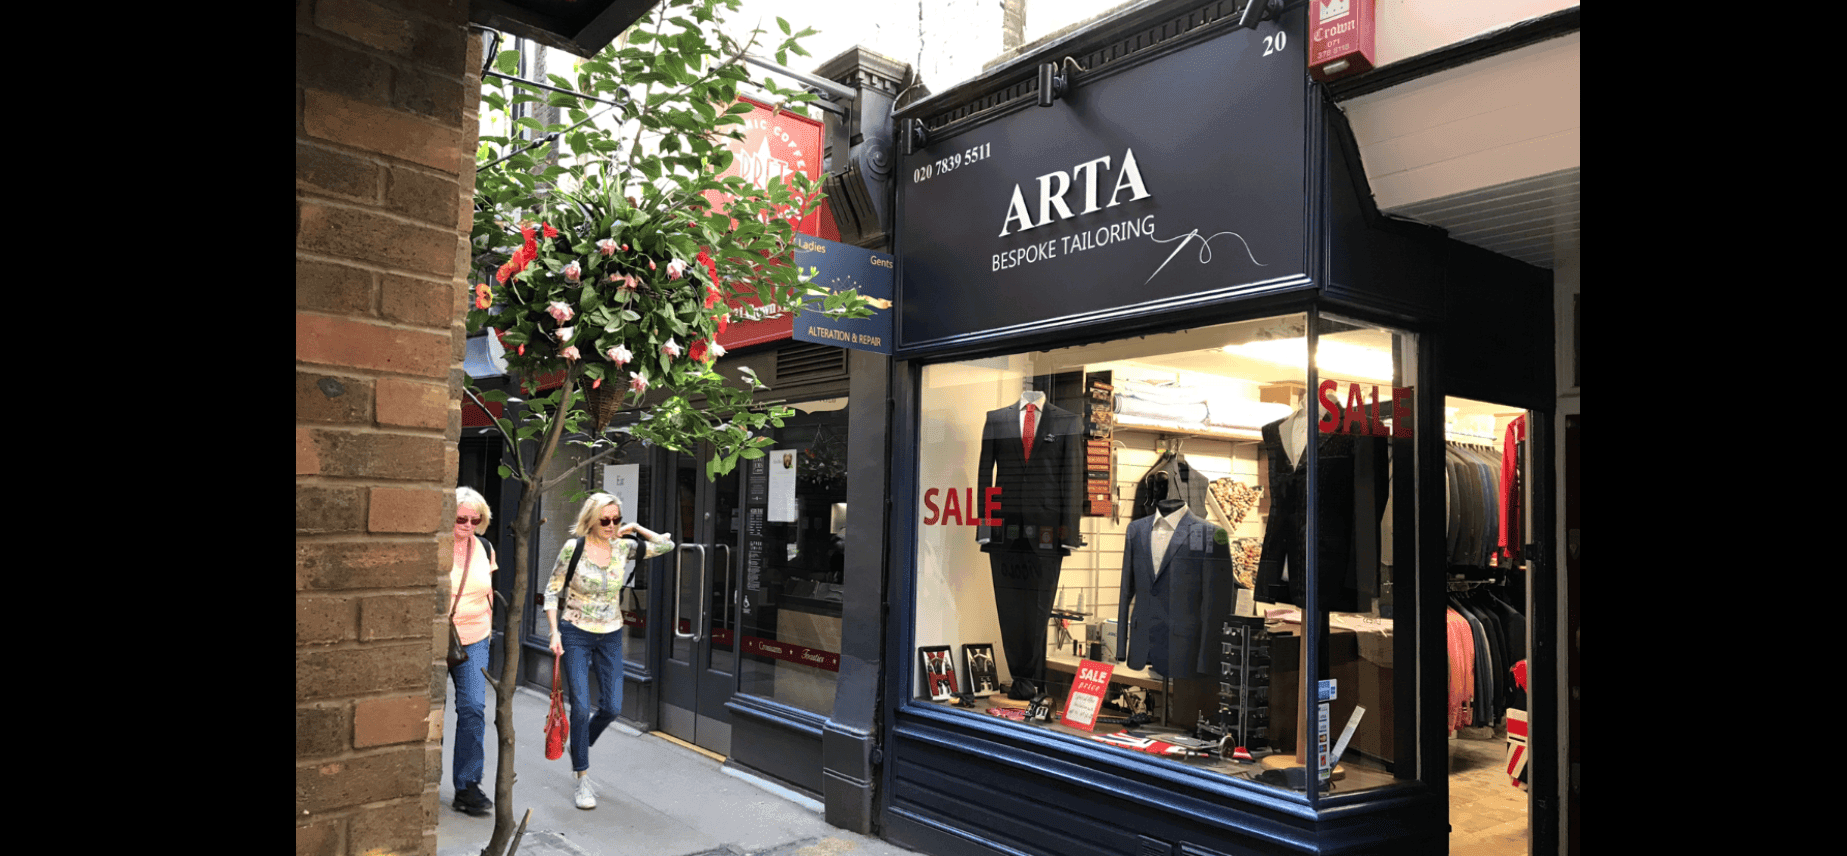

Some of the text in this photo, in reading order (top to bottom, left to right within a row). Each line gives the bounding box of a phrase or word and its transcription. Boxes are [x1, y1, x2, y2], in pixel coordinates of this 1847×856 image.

[1314, 20, 1355, 41] Crown
[1262, 31, 1287, 57] 20
[914, 142, 992, 184] 020 7839 5511
[999, 148, 1151, 237] ARTA
[798, 238, 826, 254] Ladies
[992, 215, 1155, 272] BESPOKE TAILORING
[870, 255, 894, 269] Gents
[808, 325, 882, 347] ALTERATION & REPAIR
[1318, 379, 1414, 438] SALE
[923, 487, 1003, 526] SALE
[1077, 681, 1101, 693] price
[1078, 667, 1108, 684] SALE
